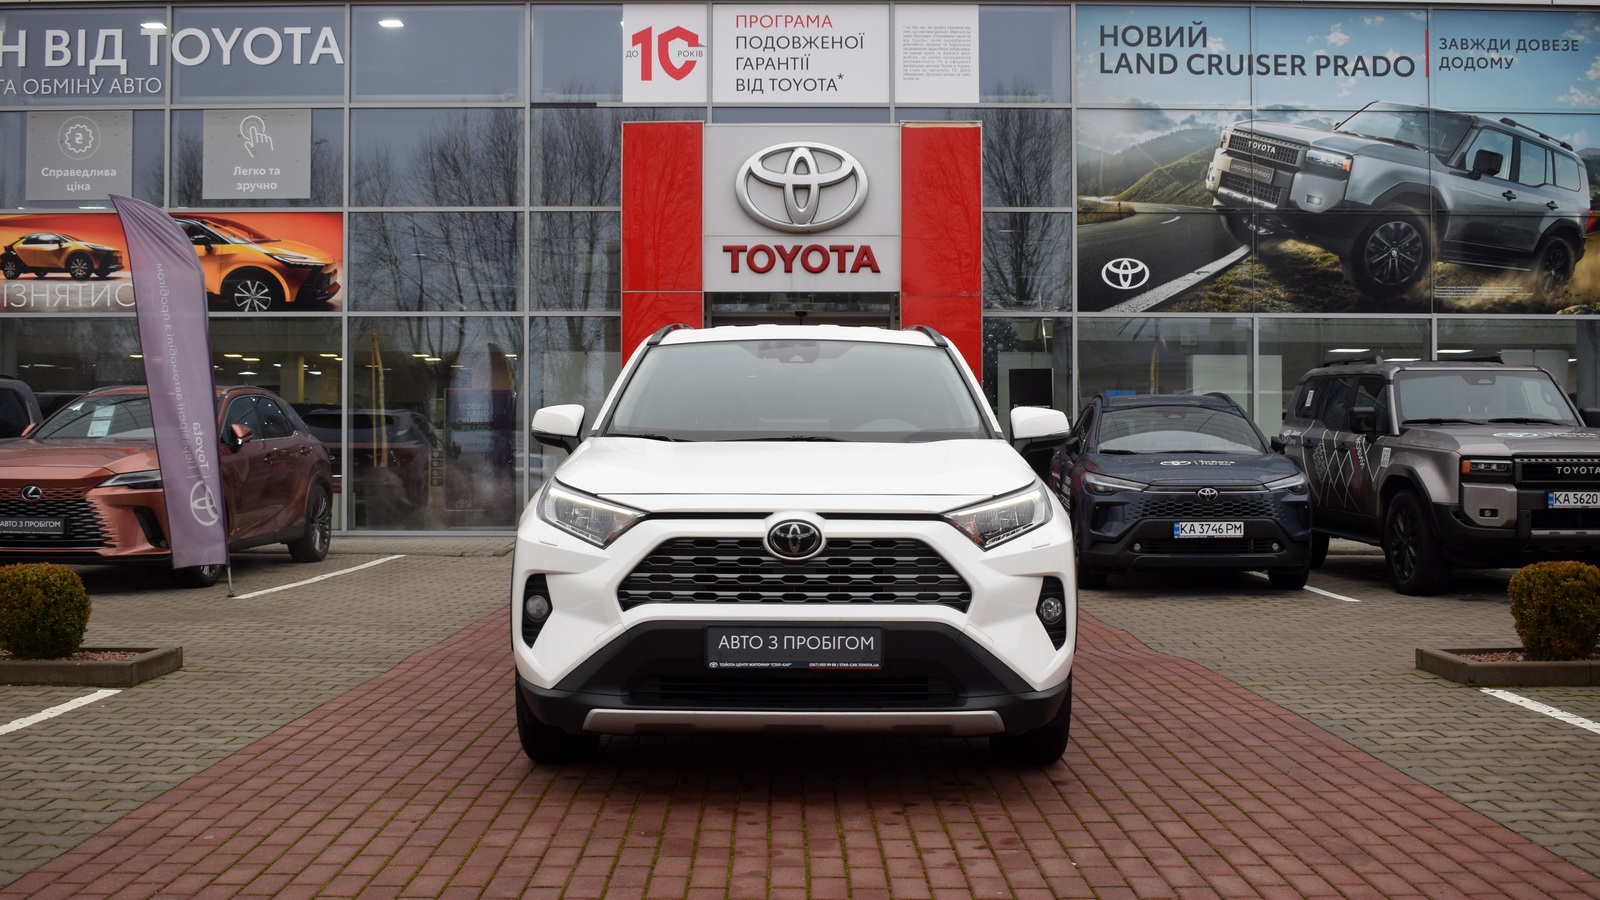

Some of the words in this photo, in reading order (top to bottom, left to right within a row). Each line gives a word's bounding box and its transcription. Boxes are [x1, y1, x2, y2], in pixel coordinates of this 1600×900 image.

[736, 15, 832, 28] ПРОГРАМА
[736, 33, 864, 51] ПОДОВЖЕНОЇ
[1100, 21, 1208, 48] НОВИЙ
[45, 28, 128, 75] ВІД
[140, 26, 344, 66] TOYOTA
[1439, 37, 1512, 53] ЗАВЖДИ
[1516, 38, 1580, 54] ДОВЕЗЕ
[736, 54, 810, 70] ГАРАНТІЇ
[1100, 54, 1178, 75] LAND
[1186, 54, 1307, 77] CRUISER
[1316, 55, 1416, 78] PRADO
[1439, 56, 1514, 72] ДОДОМУ
[23, 78, 104, 95] ОБМІНУ
[109, 77, 162, 94] АВТО
[736, 78, 764, 94] ВІД
[1248, 141, 1276, 154] TOYOTA
[41, 168, 117, 179] Справедлива
[233, 166, 266, 177] Легко
[66, 182, 91, 193] ціна
[236, 182, 278, 193] зручно
[723, 244, 881, 274] TOYOTA
[4, 283, 136, 307] ІЗНЯТИС
[1573, 494, 1598, 504] 5620
[1198, 524, 1224, 534] 3746
[718, 636, 763, 650] АВТО
[768, 636, 778, 650] З
[784, 636, 874, 650] ПРОБІГОМ
